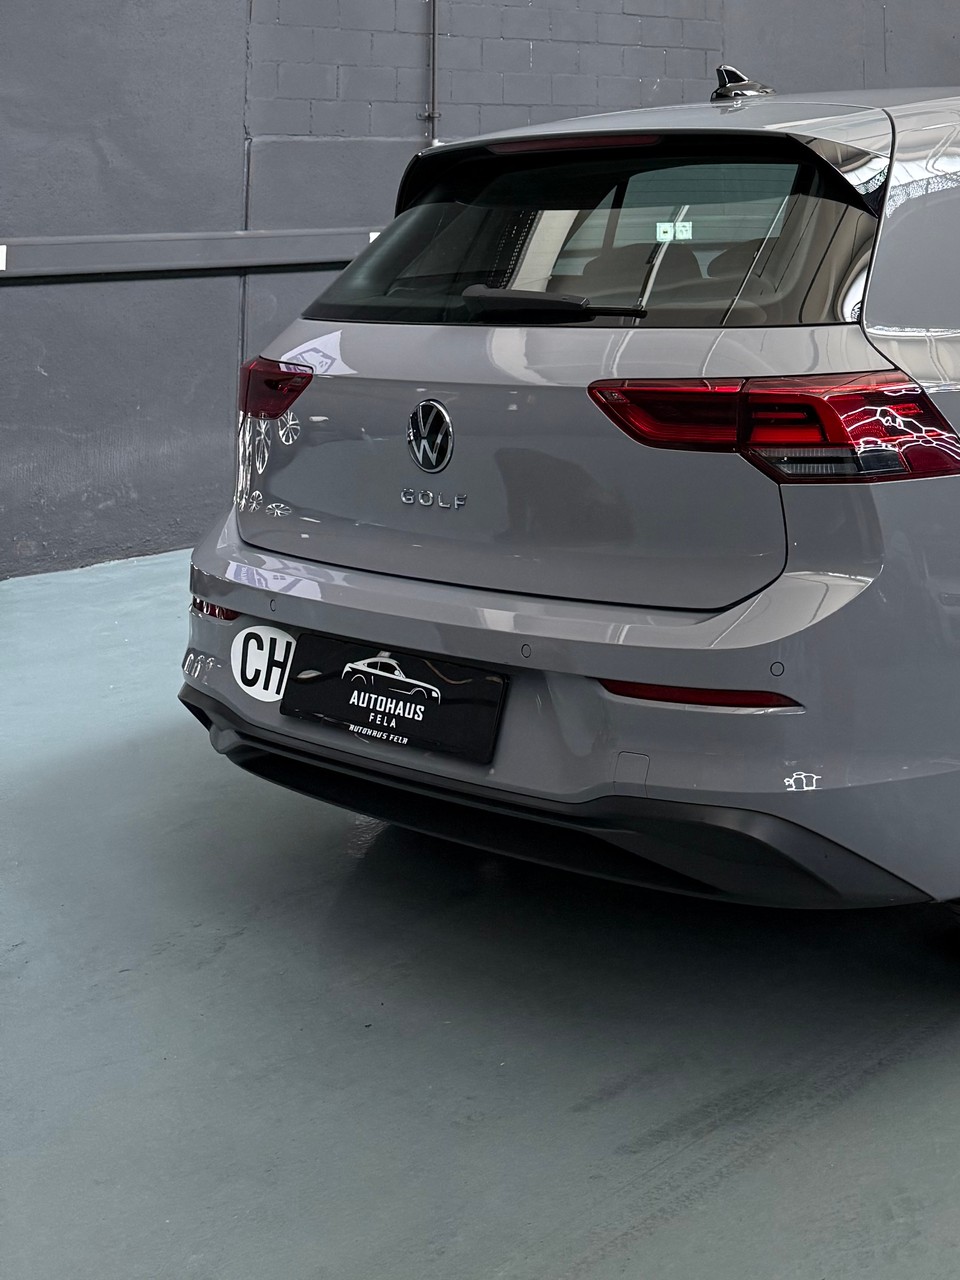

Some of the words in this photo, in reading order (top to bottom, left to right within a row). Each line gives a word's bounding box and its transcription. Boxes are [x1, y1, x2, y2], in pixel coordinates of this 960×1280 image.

[401, 488, 467, 509] GOLF
[240, 632, 292, 696] CH
[349, 690, 425, 721] AUTOHAUS
[368, 713, 396, 729] FELA
[348, 724, 388, 741] AUTOHAUS
[389, 734, 409, 745] FELA
